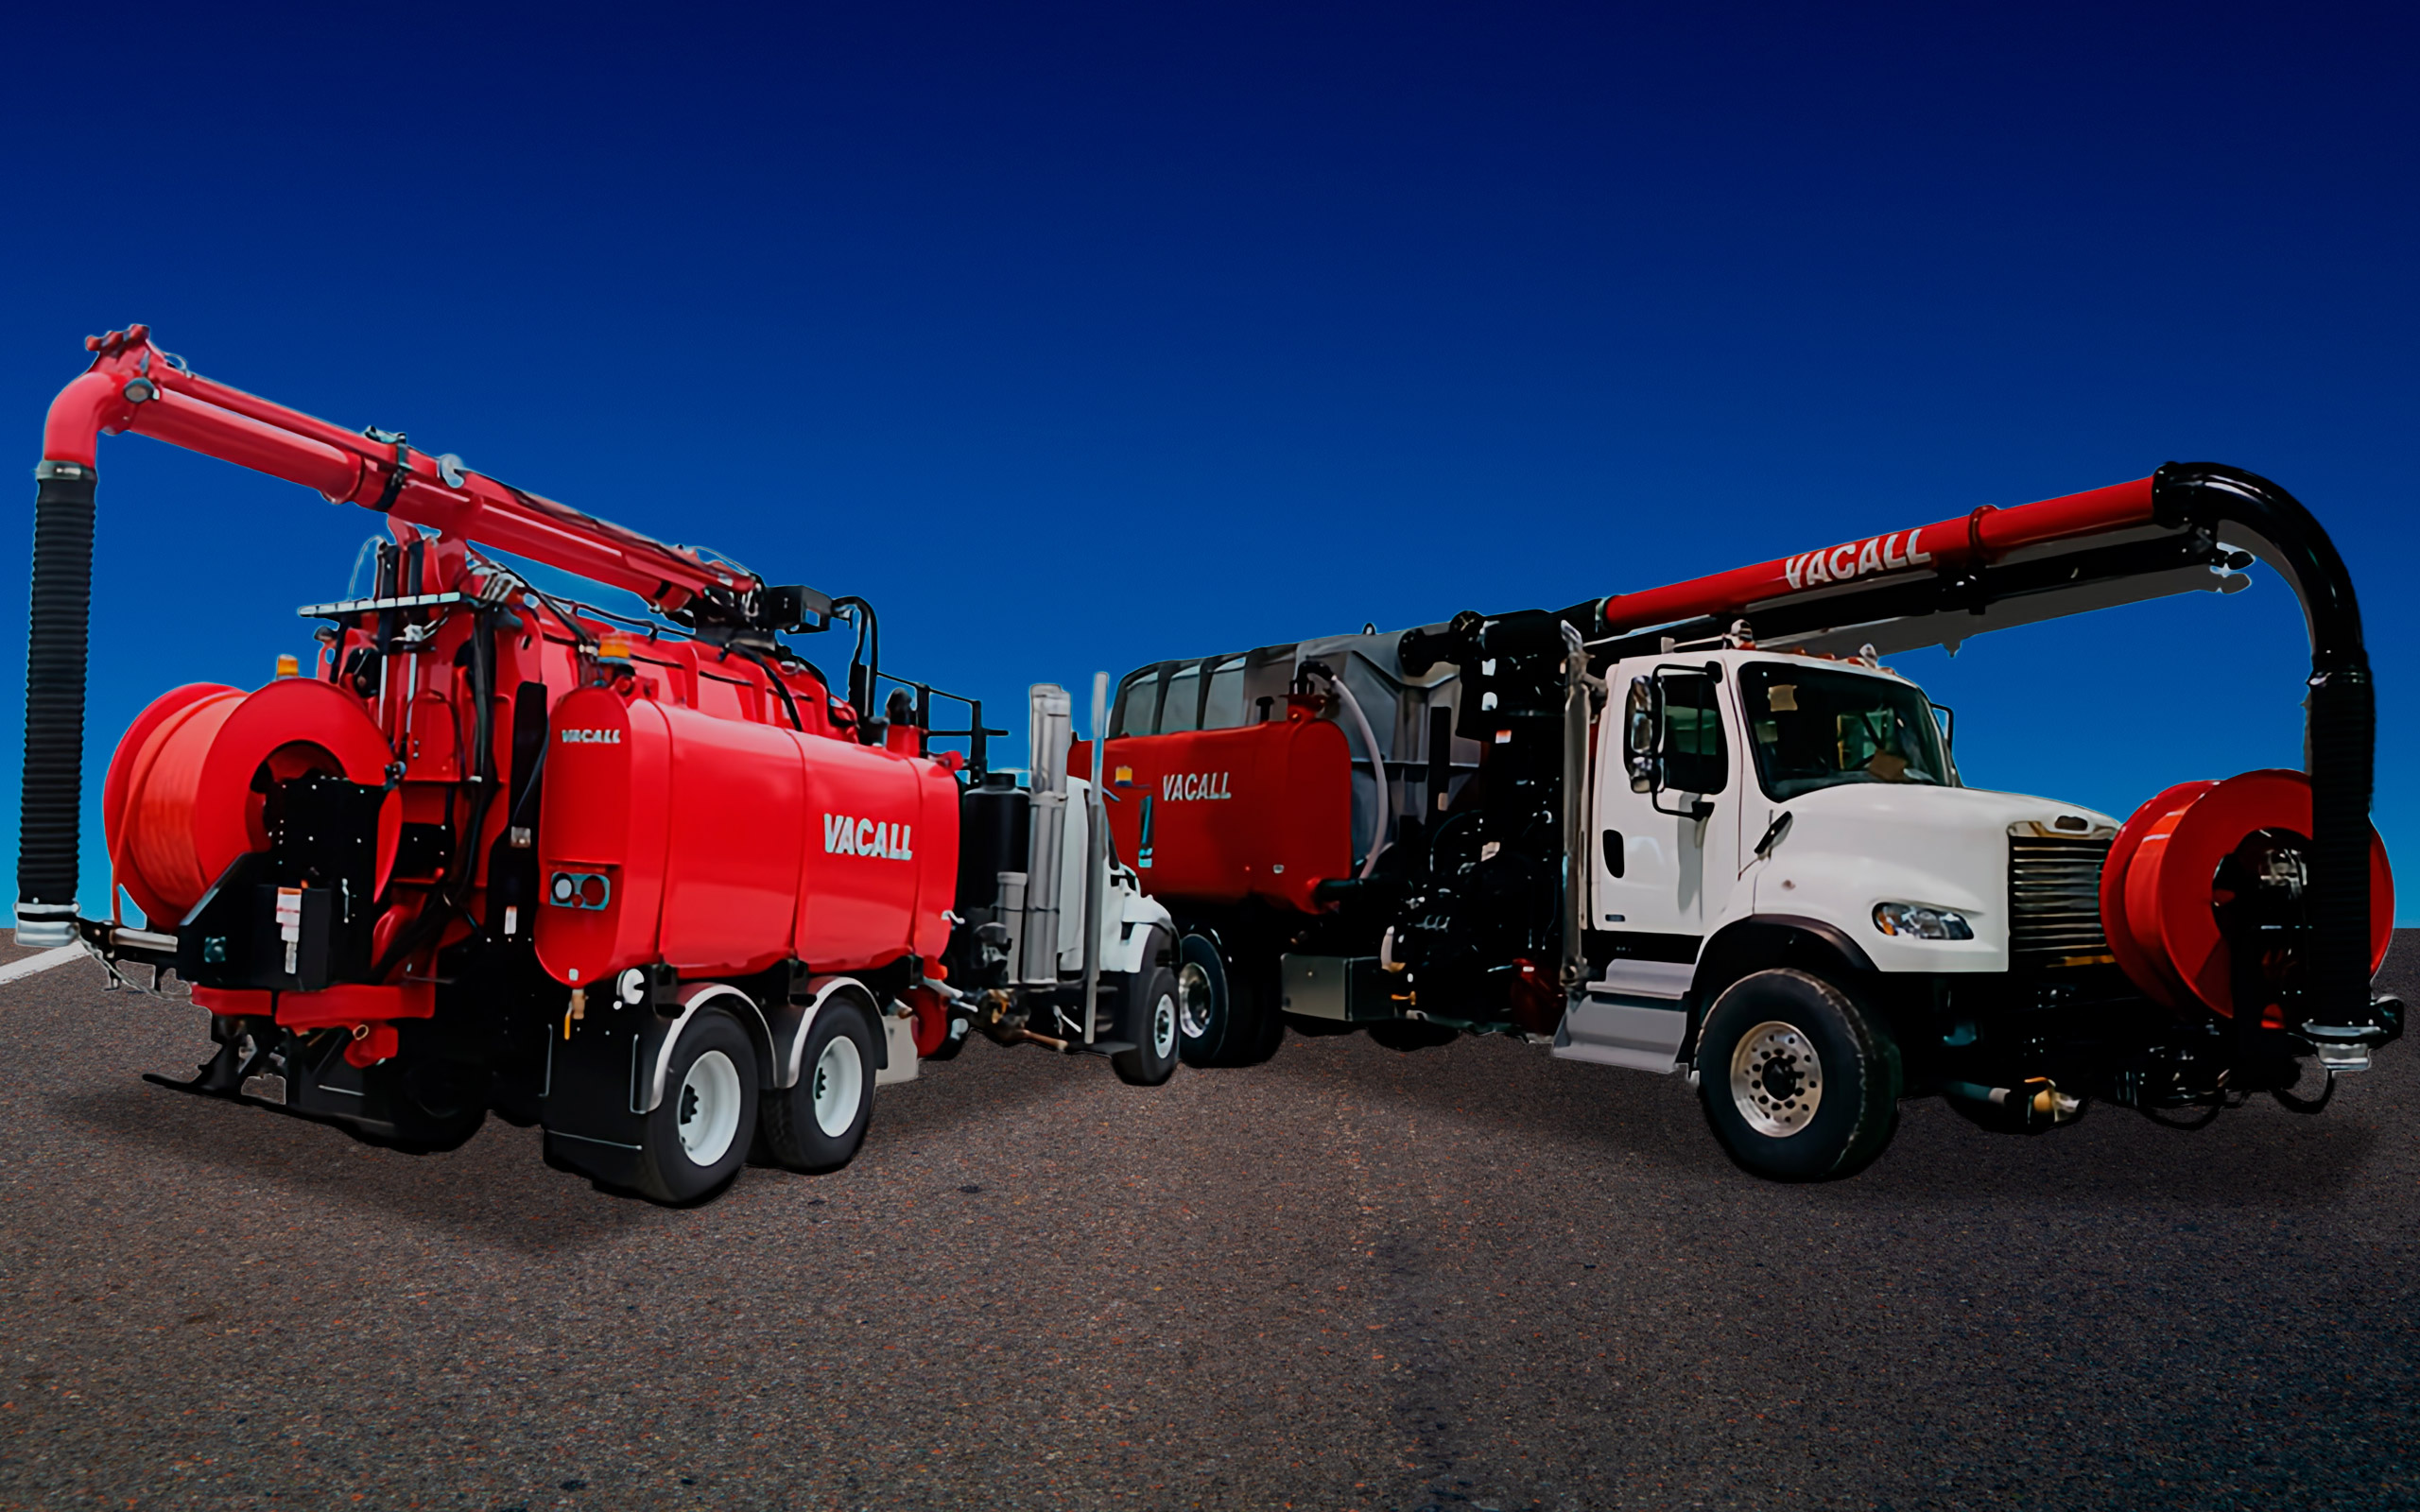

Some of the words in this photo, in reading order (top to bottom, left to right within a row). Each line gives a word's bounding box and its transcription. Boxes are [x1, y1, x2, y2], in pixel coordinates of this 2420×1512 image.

[1786, 529, 1932, 589] VACALL
[1163, 772, 1232, 801] VACALL
[823, 813, 913, 861] VACALL
